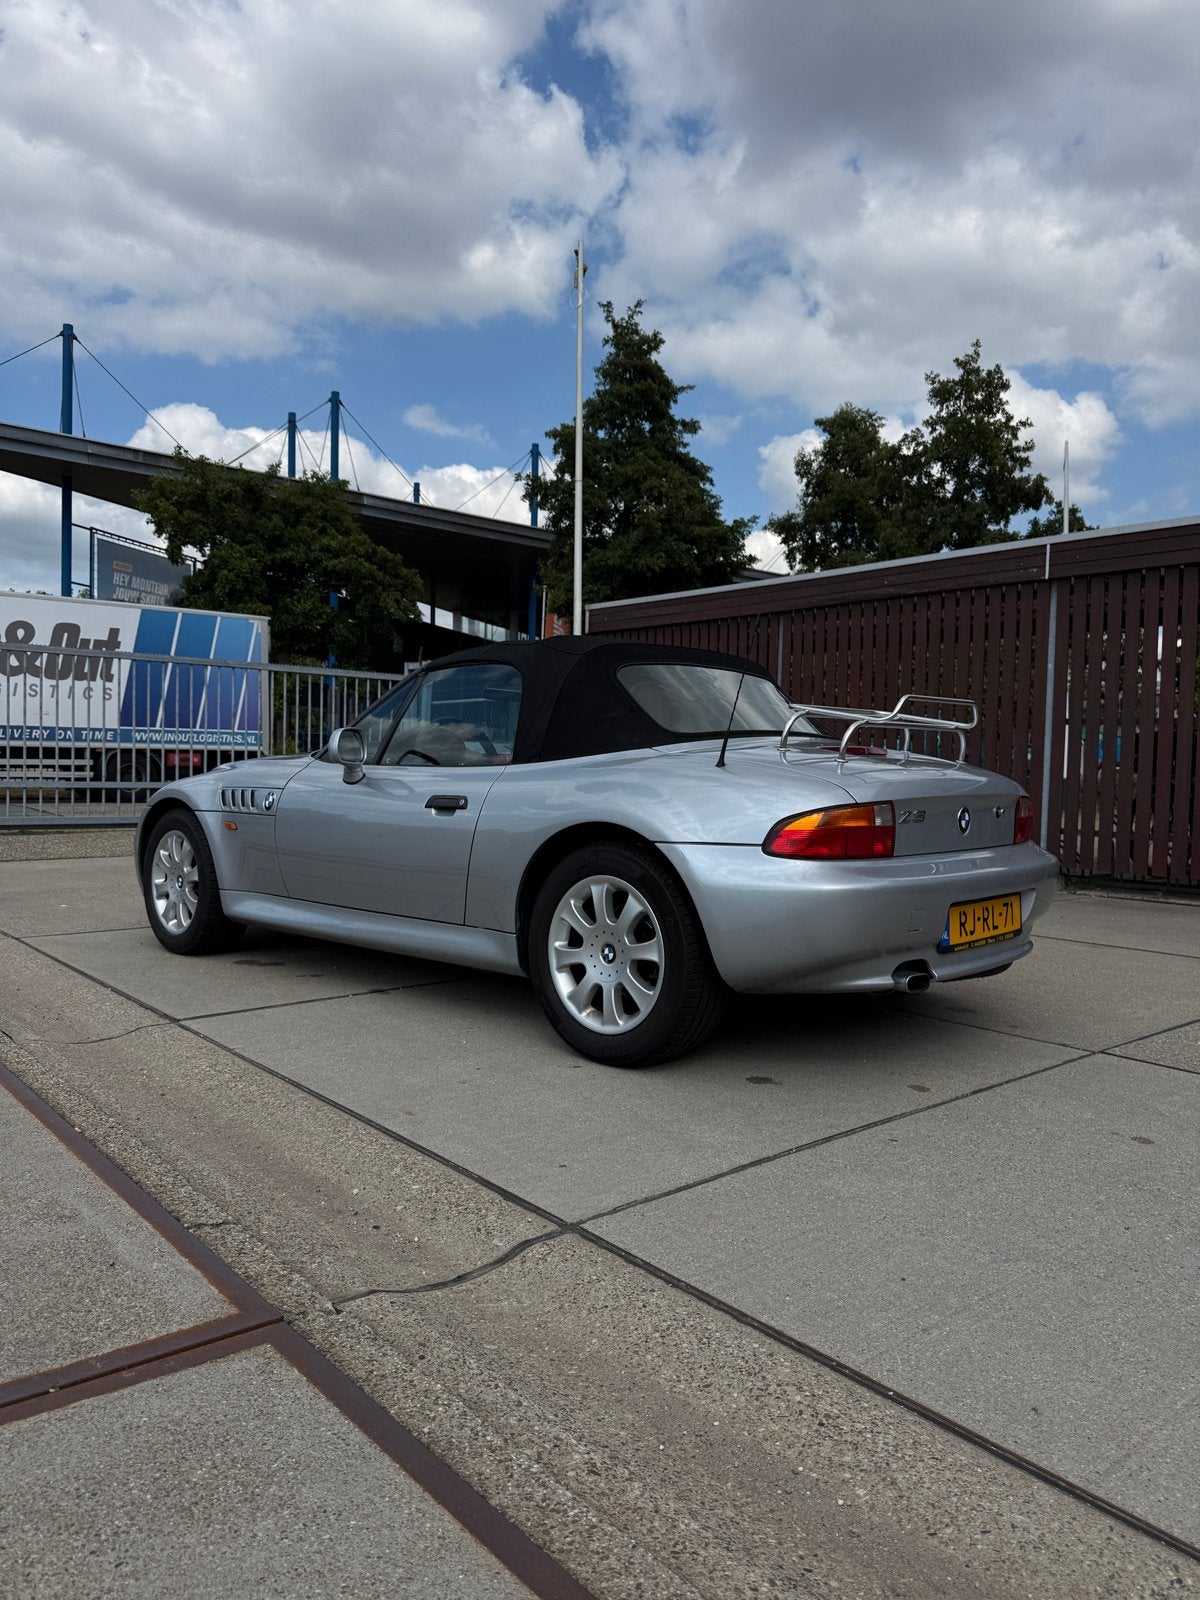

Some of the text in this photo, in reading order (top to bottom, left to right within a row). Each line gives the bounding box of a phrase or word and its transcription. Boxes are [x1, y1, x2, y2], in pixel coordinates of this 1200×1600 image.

[113, 572, 130, 587] HEY
[112, 587, 139, 603] JOUW
[0, 682, 113, 701] ISTICS
[81, 731, 115, 741] TIME
[132, 732, 257, 744] WWWINOULOGISTICS.NL
[958, 901, 1014, 938] RJ-RL-71
